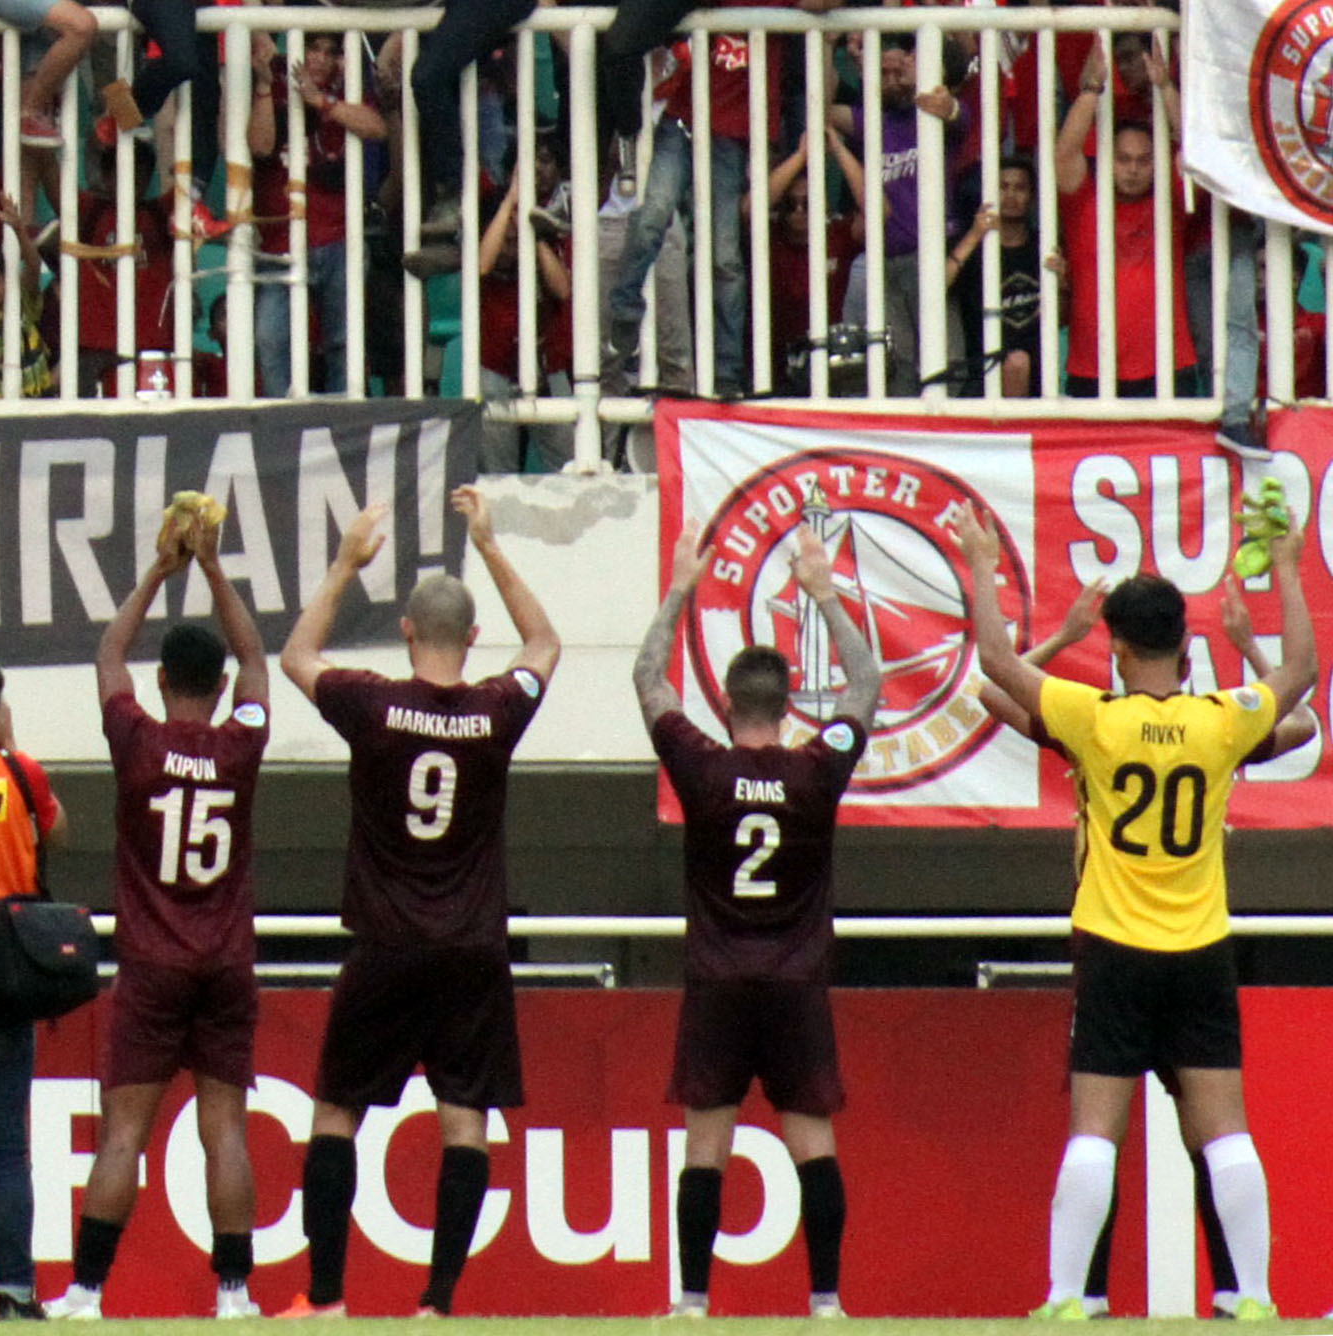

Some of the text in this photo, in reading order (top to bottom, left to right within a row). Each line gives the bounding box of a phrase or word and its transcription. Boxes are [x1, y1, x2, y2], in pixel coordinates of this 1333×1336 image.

[713, 465, 924, 586] SUPORTER
[386, 705, 492, 739] MARKKANEN
[1140, 721, 1186, 744] RIVKY
[405, 750, 458, 840] 9
[734, 777, 786, 803] EVANS
[1111, 761, 1207, 858] 20
[148, 786, 236, 885] 15
[733, 812, 781, 898] 2
